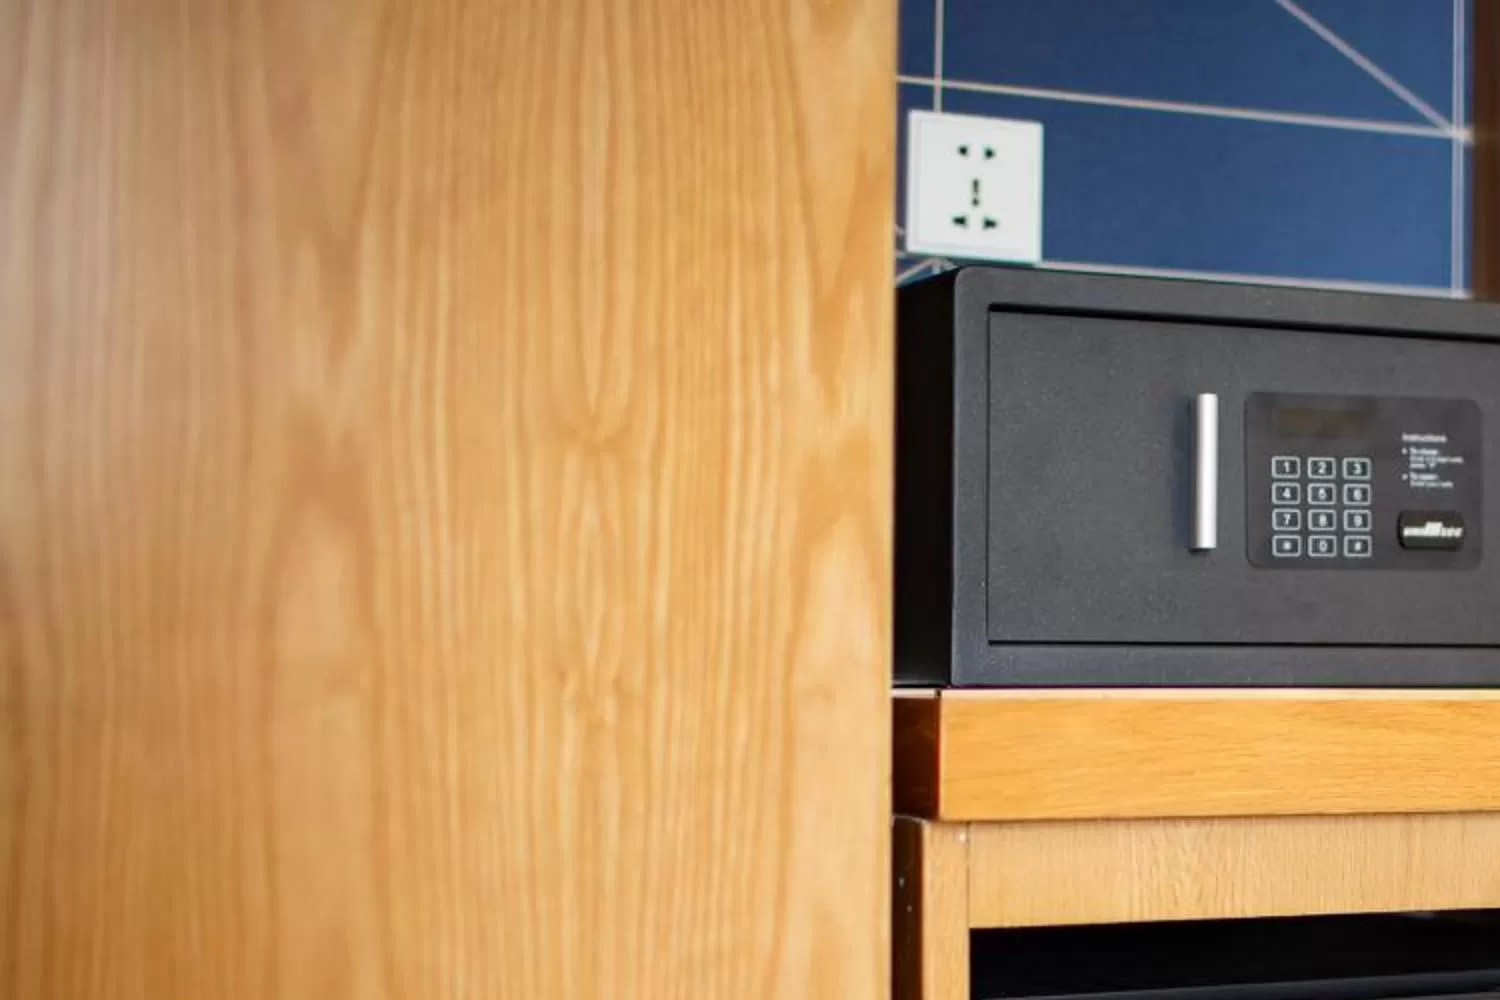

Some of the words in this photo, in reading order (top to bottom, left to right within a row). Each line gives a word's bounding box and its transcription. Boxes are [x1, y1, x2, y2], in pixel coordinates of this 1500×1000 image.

[1283, 461, 1290, 473] 1
[1318, 461, 1327, 474] 2
[1352, 462, 1362, 475] 3
[1282, 487, 1292, 499] 4
[1283, 513, 1291, 525] 7
[1319, 539, 1328, 553] 0
